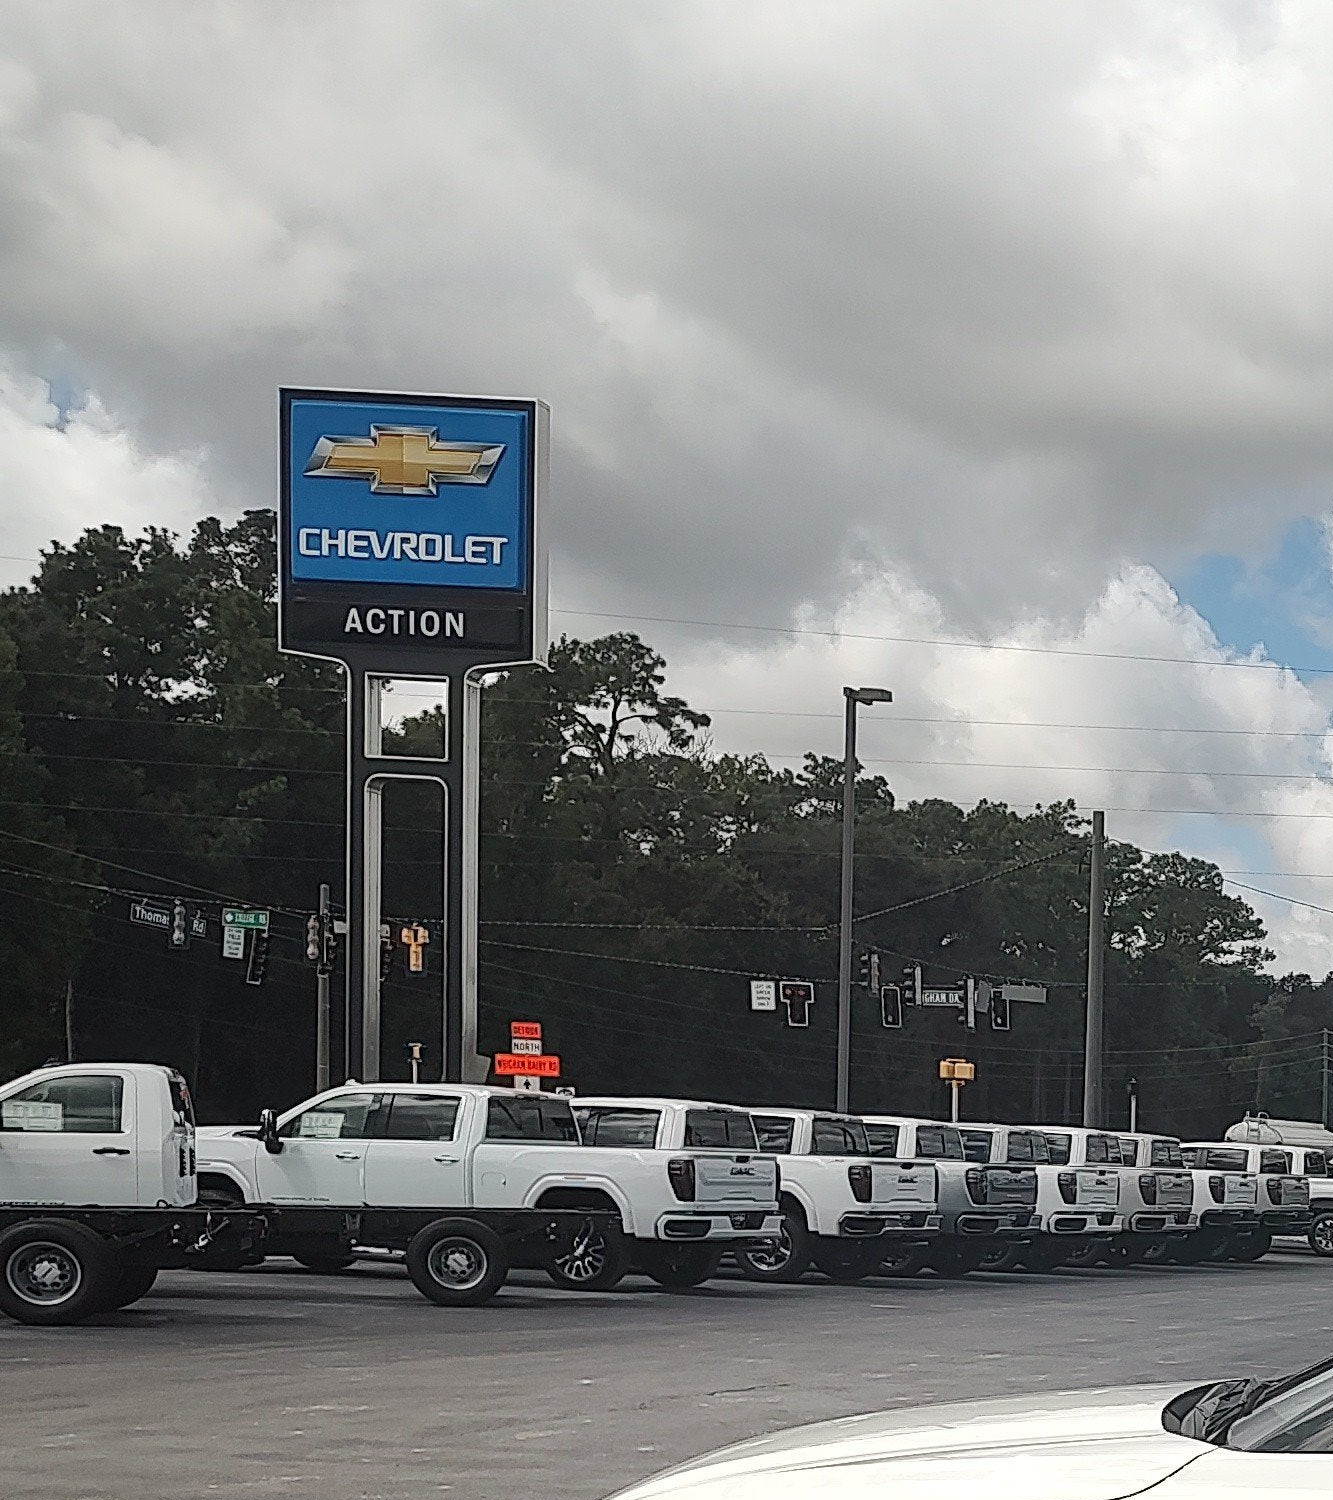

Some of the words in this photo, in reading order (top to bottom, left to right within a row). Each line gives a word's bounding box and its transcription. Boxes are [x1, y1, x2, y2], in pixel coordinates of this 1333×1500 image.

[299, 527, 509, 565] CHEVROLET
[344, 607, 465, 638] ACTION
[513, 1042, 540, 1052] NORTH
